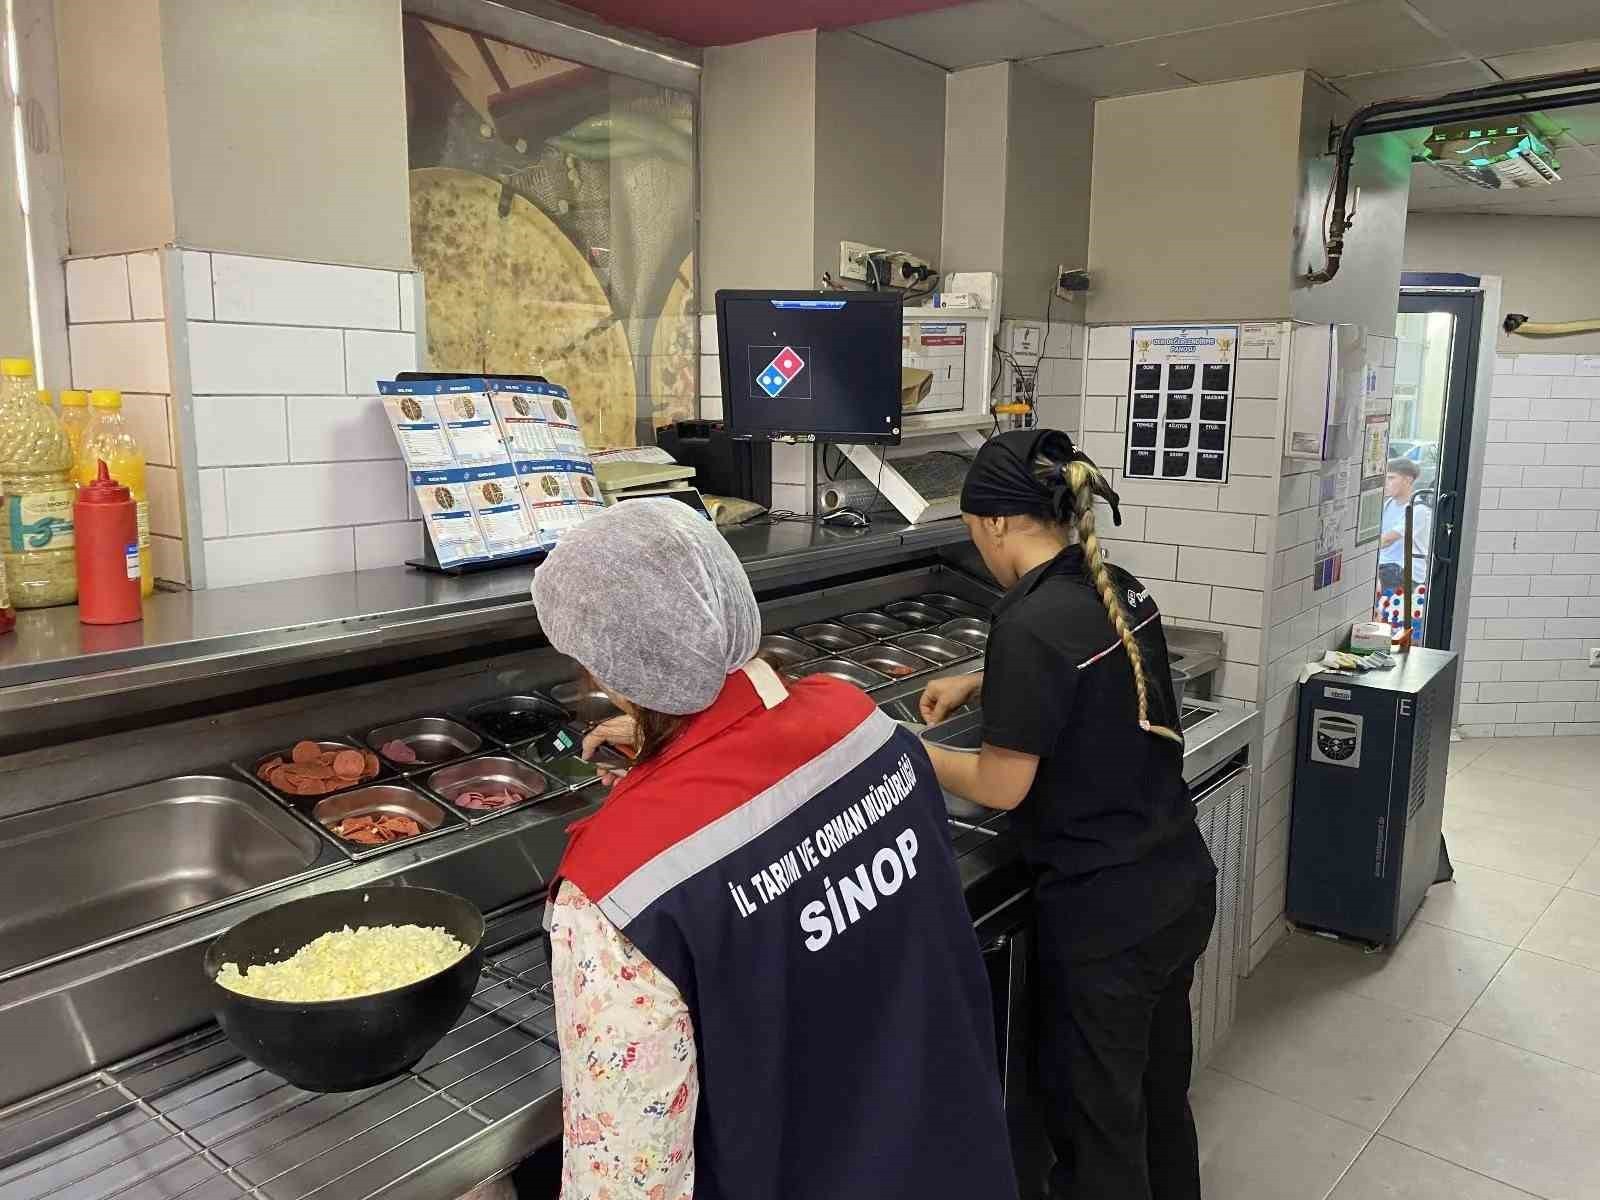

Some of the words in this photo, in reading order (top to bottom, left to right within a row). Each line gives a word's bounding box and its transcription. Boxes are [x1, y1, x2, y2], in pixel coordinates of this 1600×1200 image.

[728, 881, 757, 918] İL
[750, 850, 802, 904] TARIM
[796, 837, 819, 872] VE
[815, 804, 868, 858] ORMAN
[800, 828, 918, 952] SİNOP
